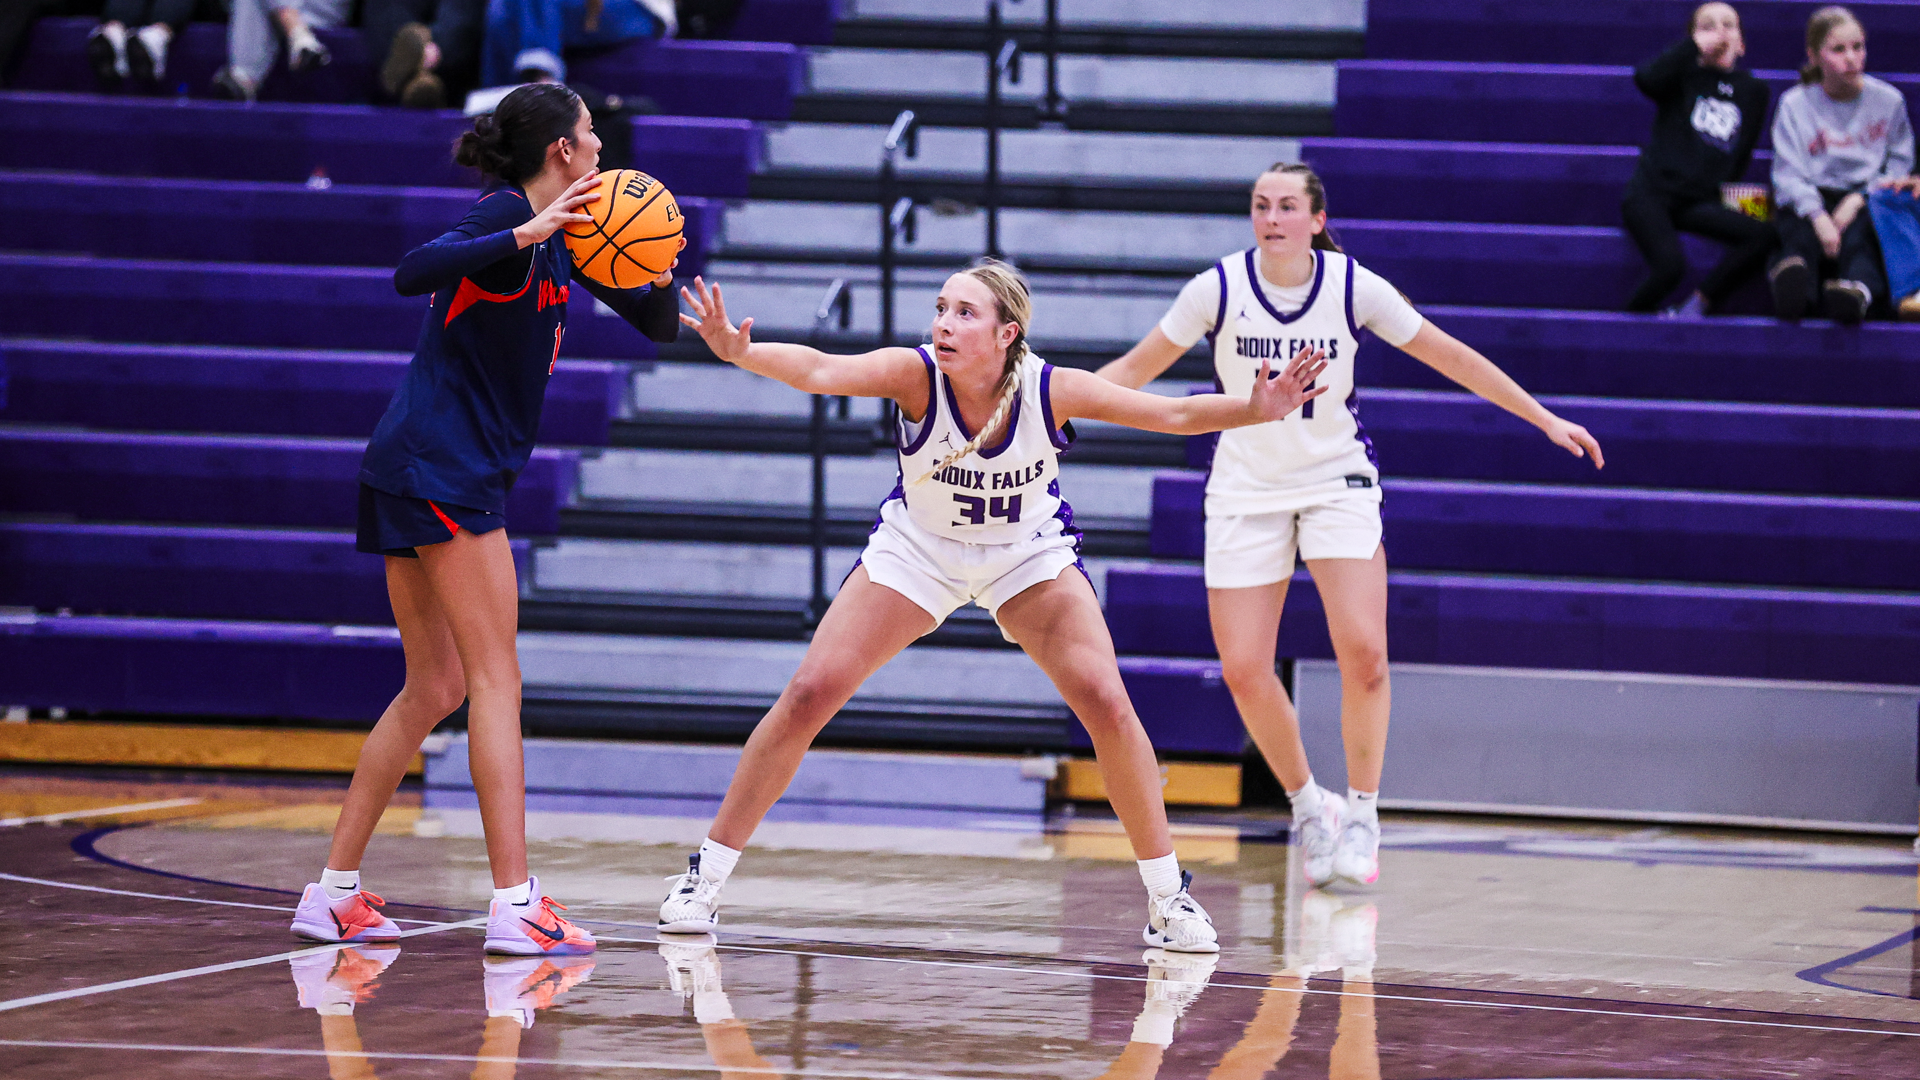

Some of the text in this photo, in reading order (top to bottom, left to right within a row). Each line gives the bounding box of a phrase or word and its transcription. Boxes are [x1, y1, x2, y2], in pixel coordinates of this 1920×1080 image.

[1236, 335, 1283, 360] SIOUX
[992, 459, 1044, 490] FALLS
[951, 492, 1023, 527] 34
